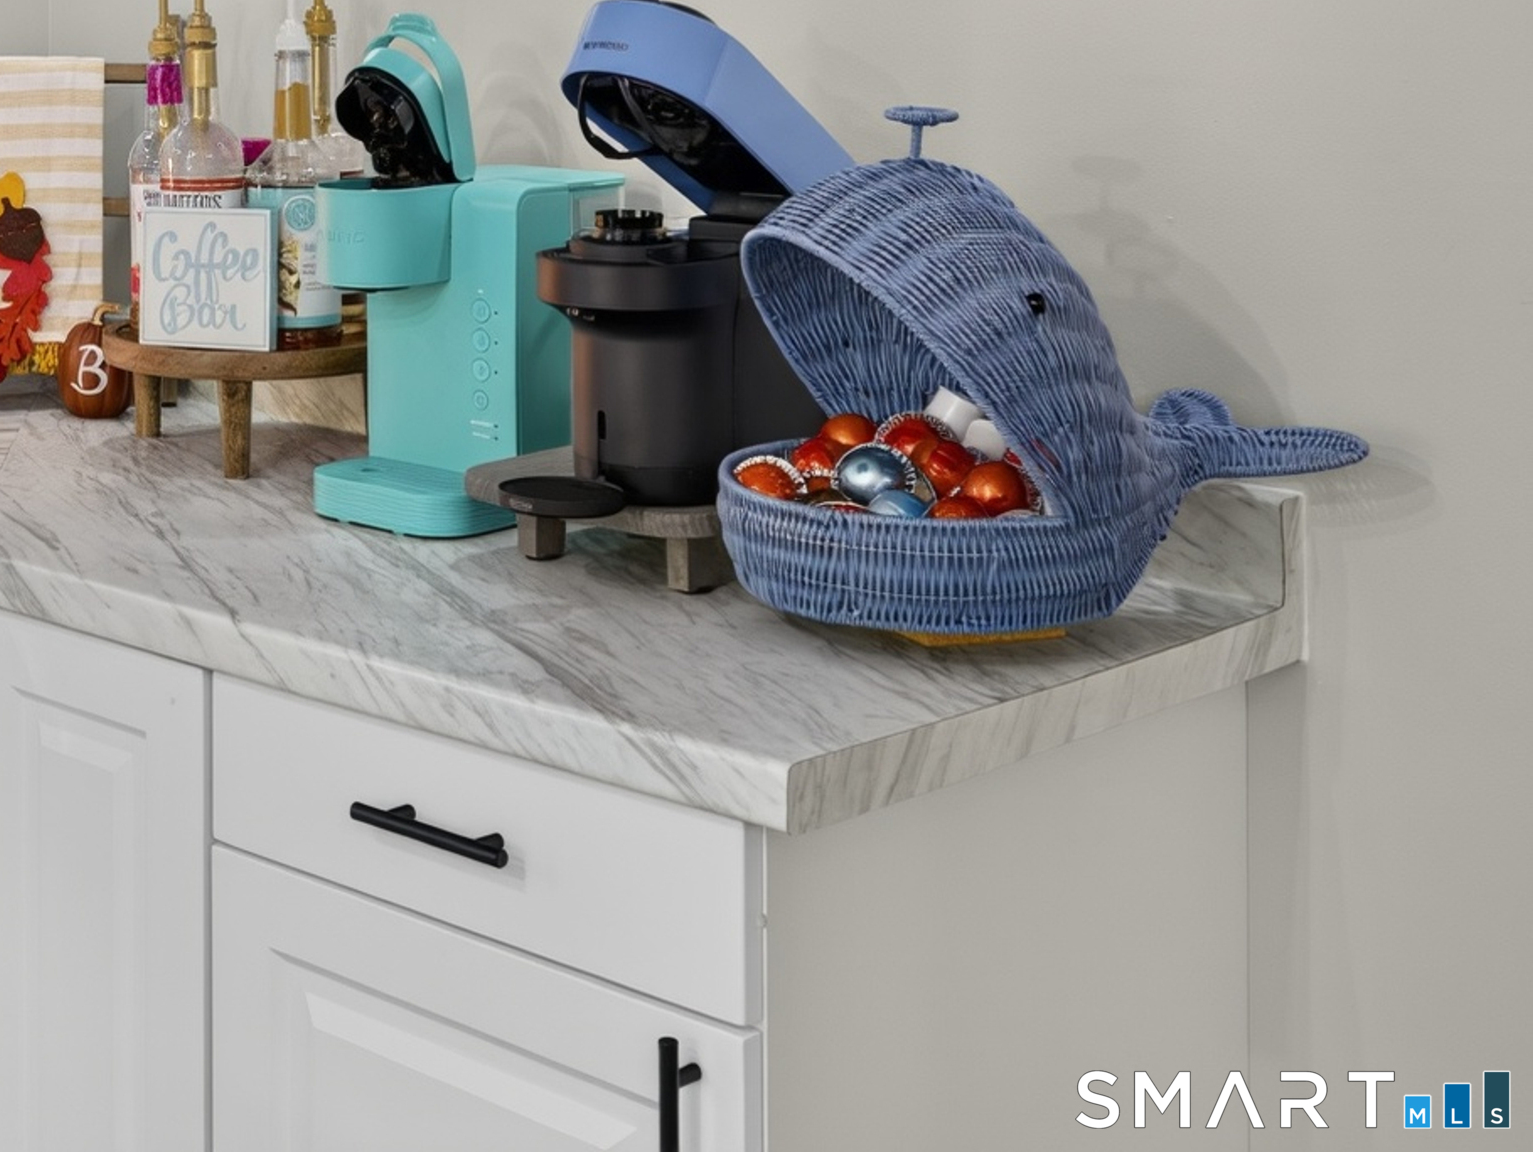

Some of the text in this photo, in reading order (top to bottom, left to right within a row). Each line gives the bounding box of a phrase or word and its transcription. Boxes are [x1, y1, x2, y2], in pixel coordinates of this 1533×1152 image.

[151, 221, 262, 305] Coffee
[159, 282, 247, 336] Bar
[70, 343, 109, 396] B
